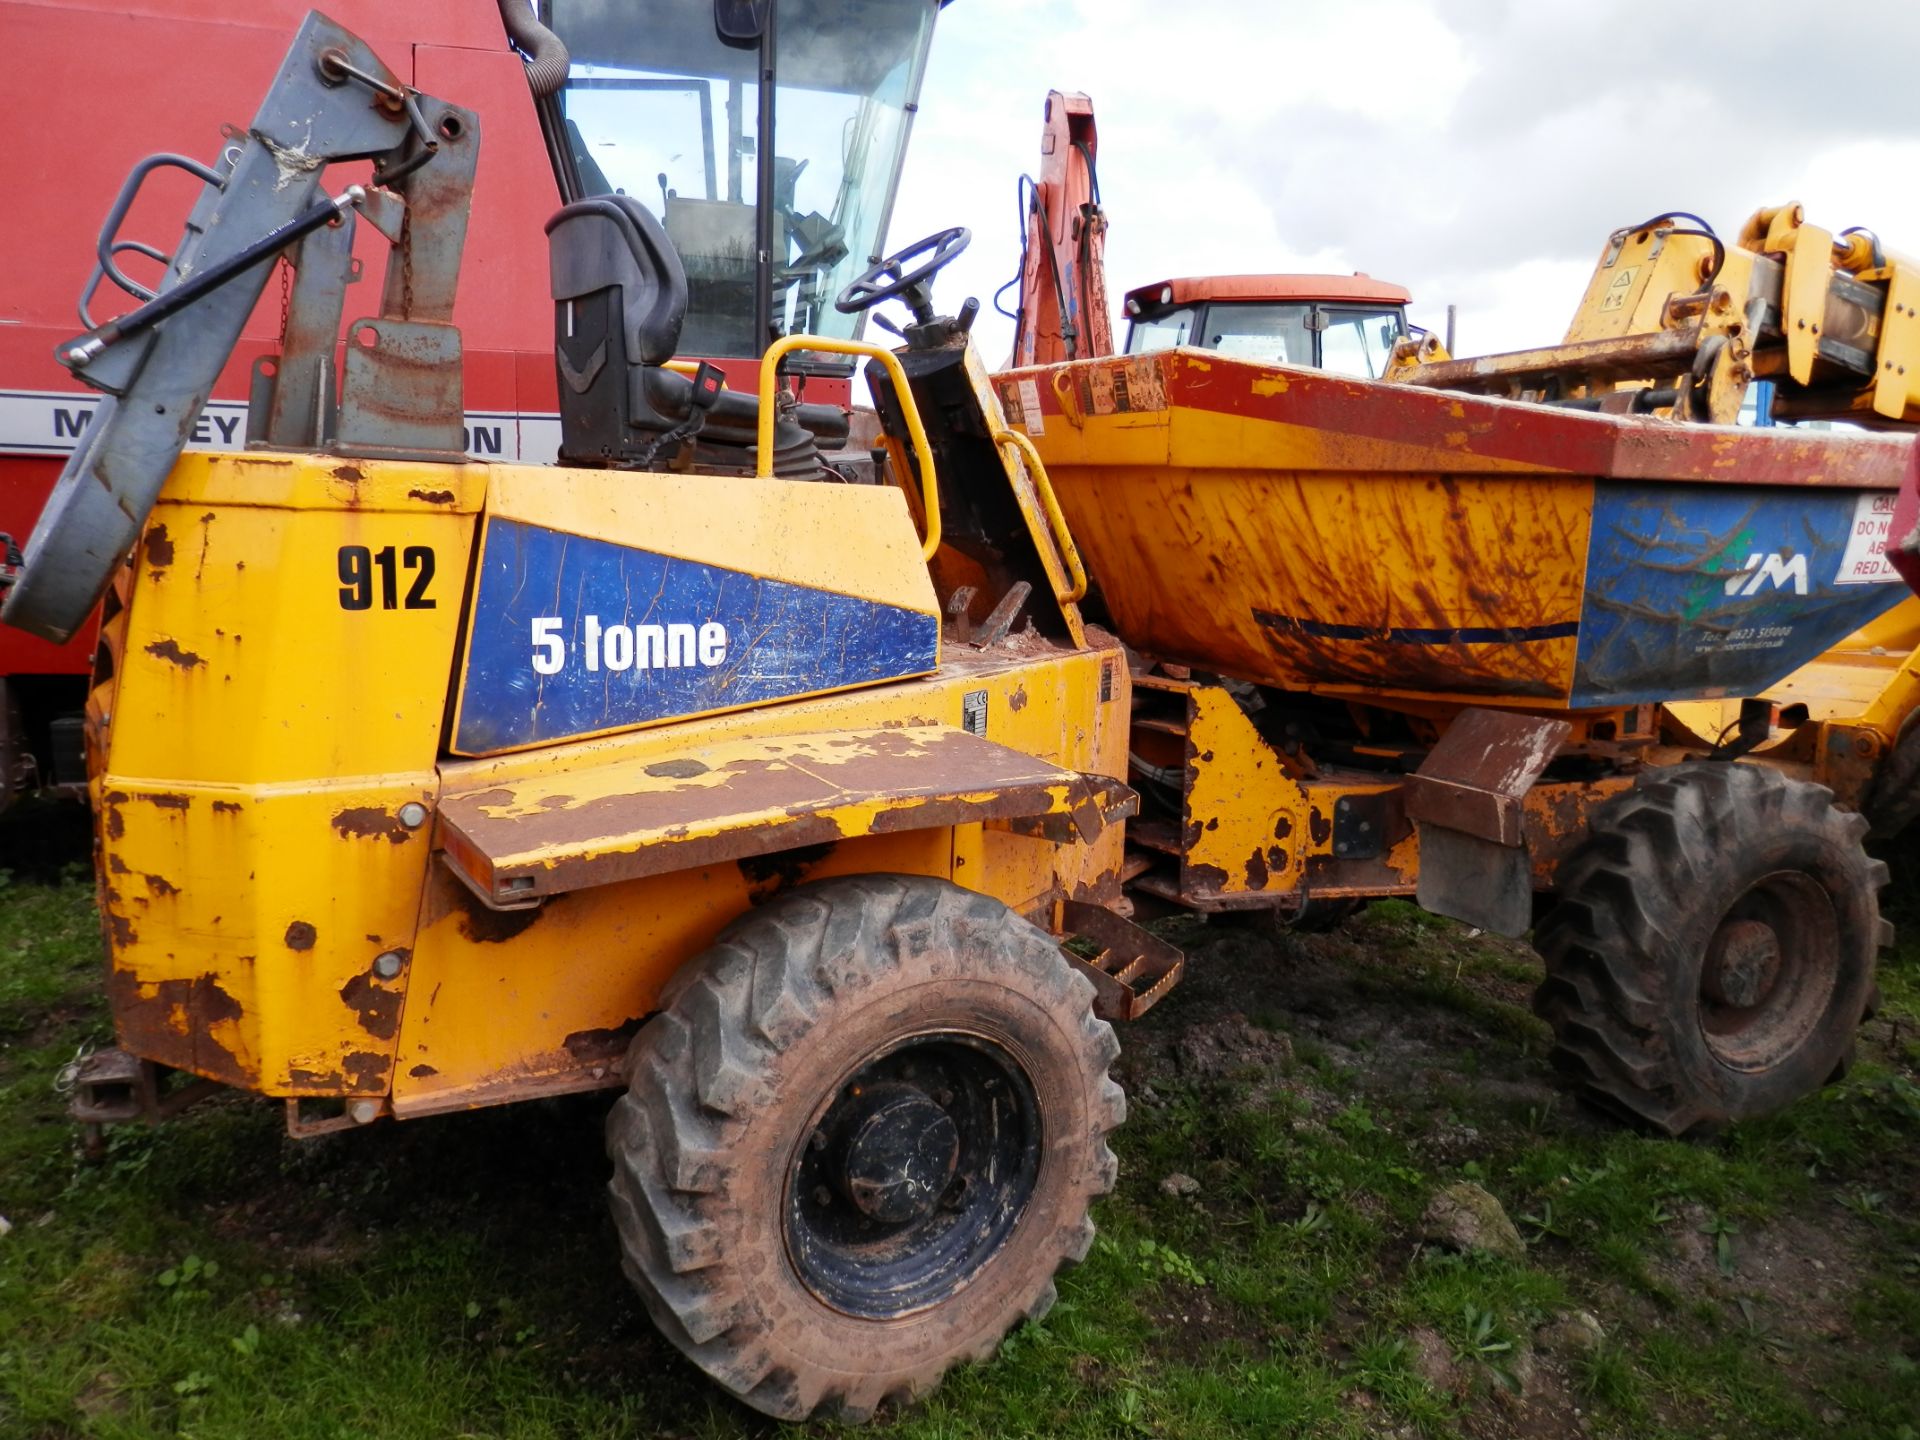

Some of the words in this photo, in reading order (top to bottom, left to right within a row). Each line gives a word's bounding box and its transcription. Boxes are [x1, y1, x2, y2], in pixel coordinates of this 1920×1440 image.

[1857, 521, 1875, 535] DO
[337, 545, 437, 611] 912
[1853, 561, 1880, 575] RED
[531, 616, 566, 675] 5
[585, 614, 728, 672] tonne
